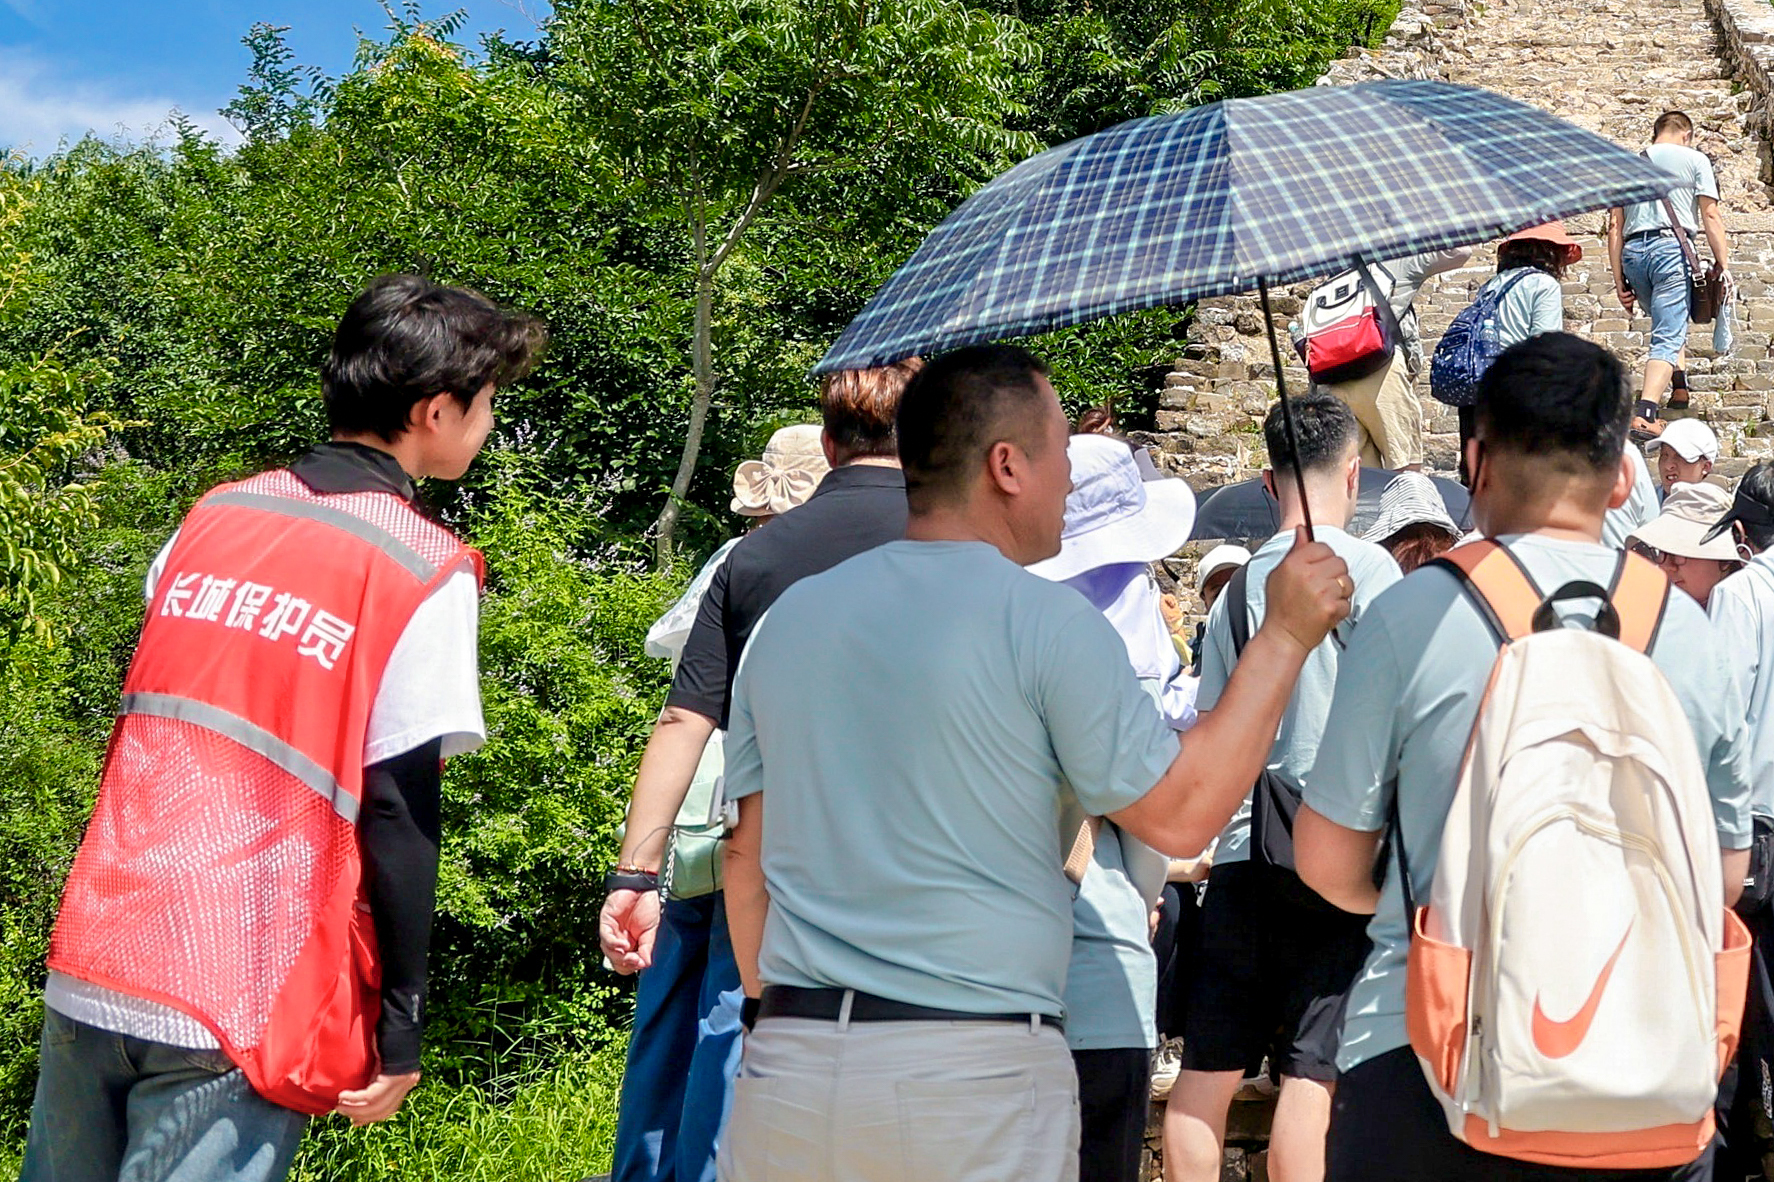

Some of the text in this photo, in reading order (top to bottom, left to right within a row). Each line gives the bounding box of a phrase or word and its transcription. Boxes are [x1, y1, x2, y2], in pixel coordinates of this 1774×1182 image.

[160, 571, 356, 671] 长城保护员
